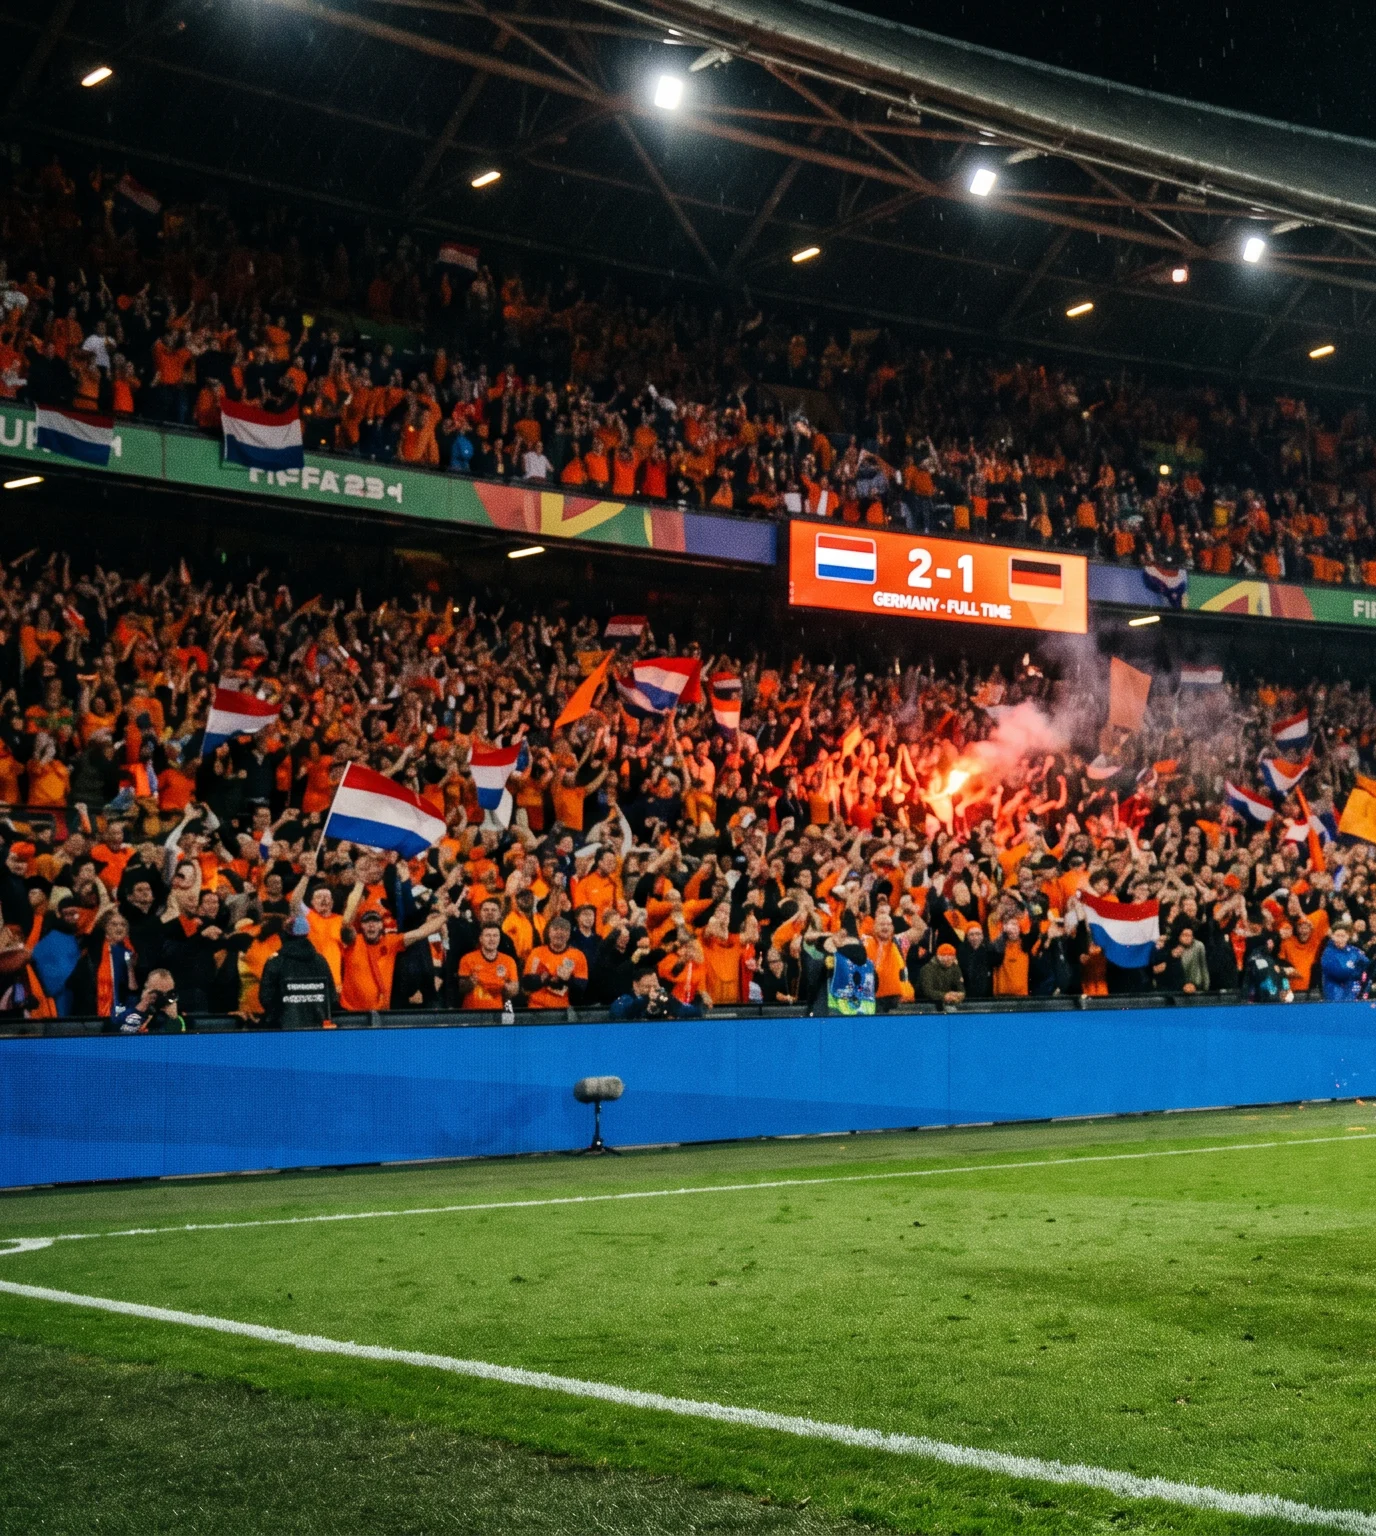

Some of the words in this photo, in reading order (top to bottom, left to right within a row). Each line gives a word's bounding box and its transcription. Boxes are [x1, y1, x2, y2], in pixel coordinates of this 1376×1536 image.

[907, 547, 973, 593] 2-1
[873, 591, 940, 612] GERMANY
[947, 599, 980, 616] FULL
[980, 602, 1012, 620] TIME
